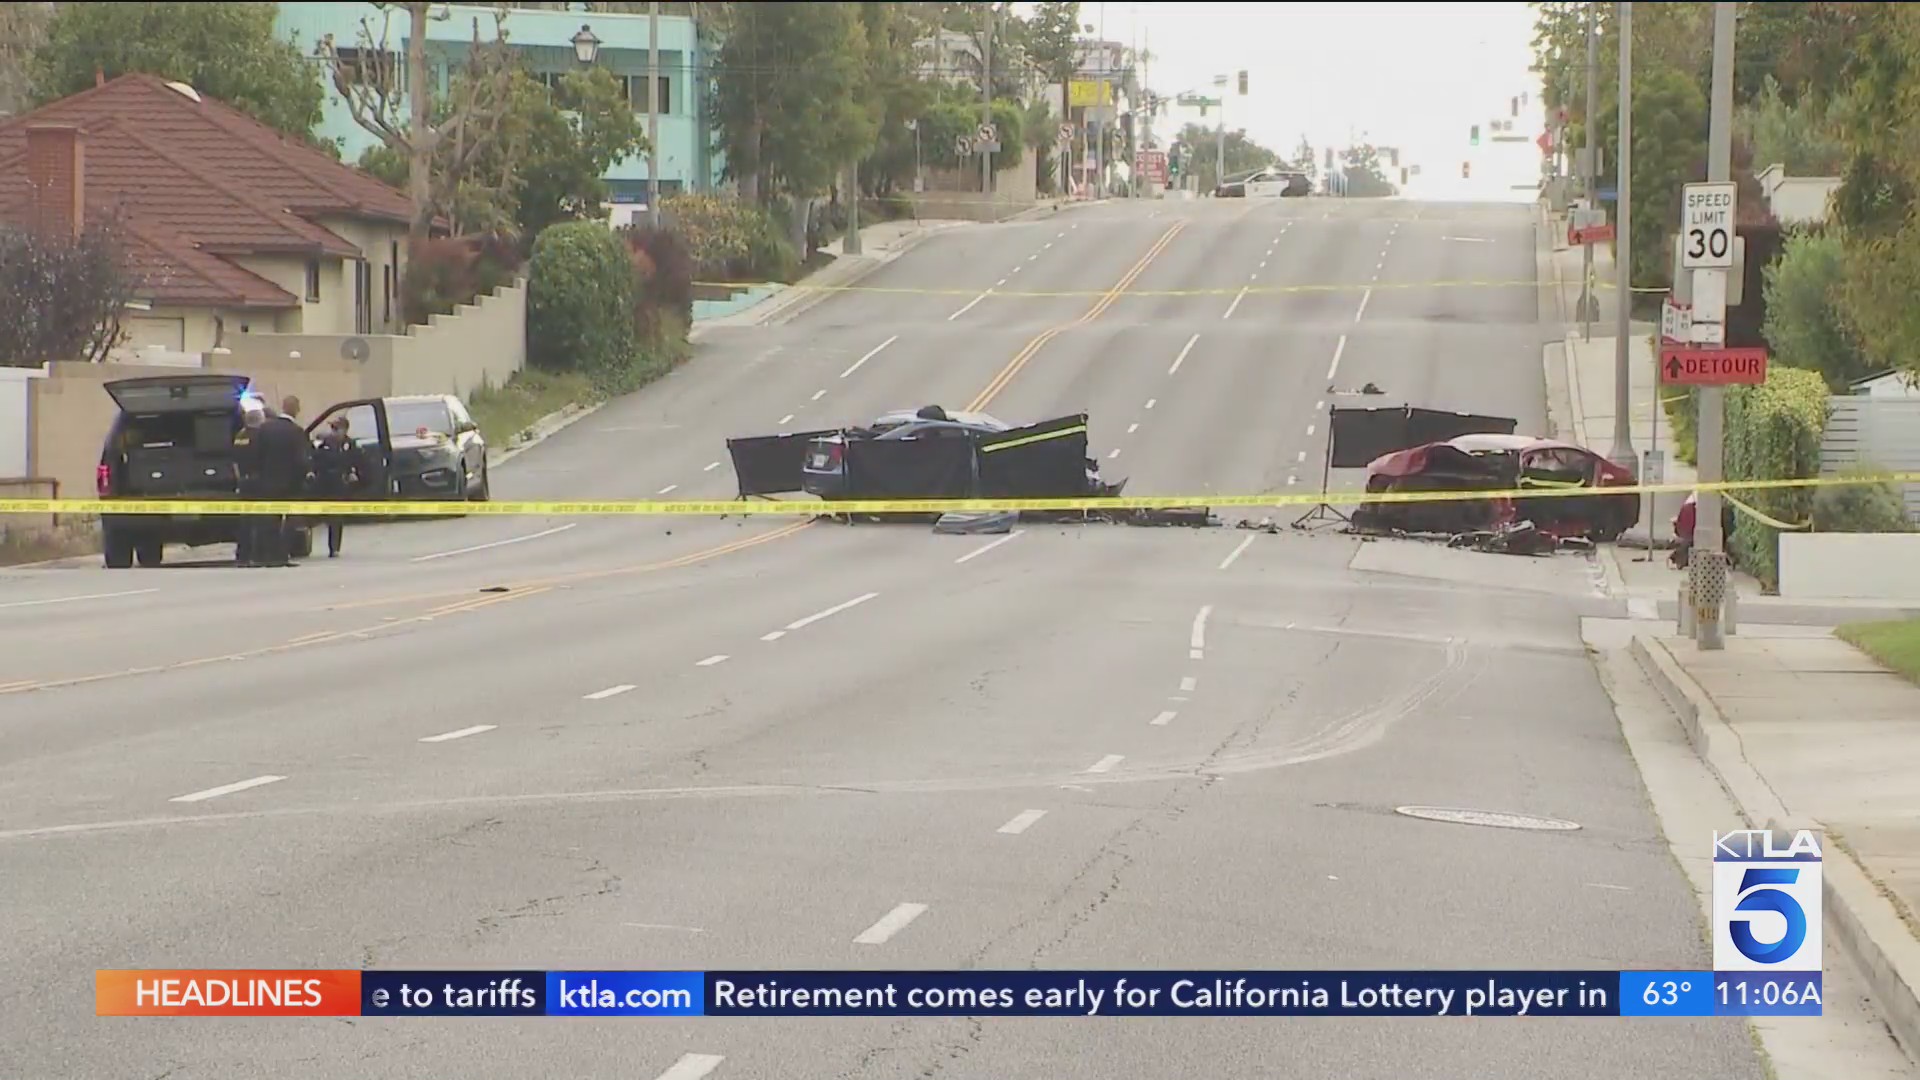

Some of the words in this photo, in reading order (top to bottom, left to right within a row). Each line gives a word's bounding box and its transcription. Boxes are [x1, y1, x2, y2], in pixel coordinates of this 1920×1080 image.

[1688, 194, 1731, 207] SPEED
[1692, 211, 1726, 224] LIMIT
[1688, 228, 1728, 258] 30
[1686, 358, 1760, 375] DETOUR
